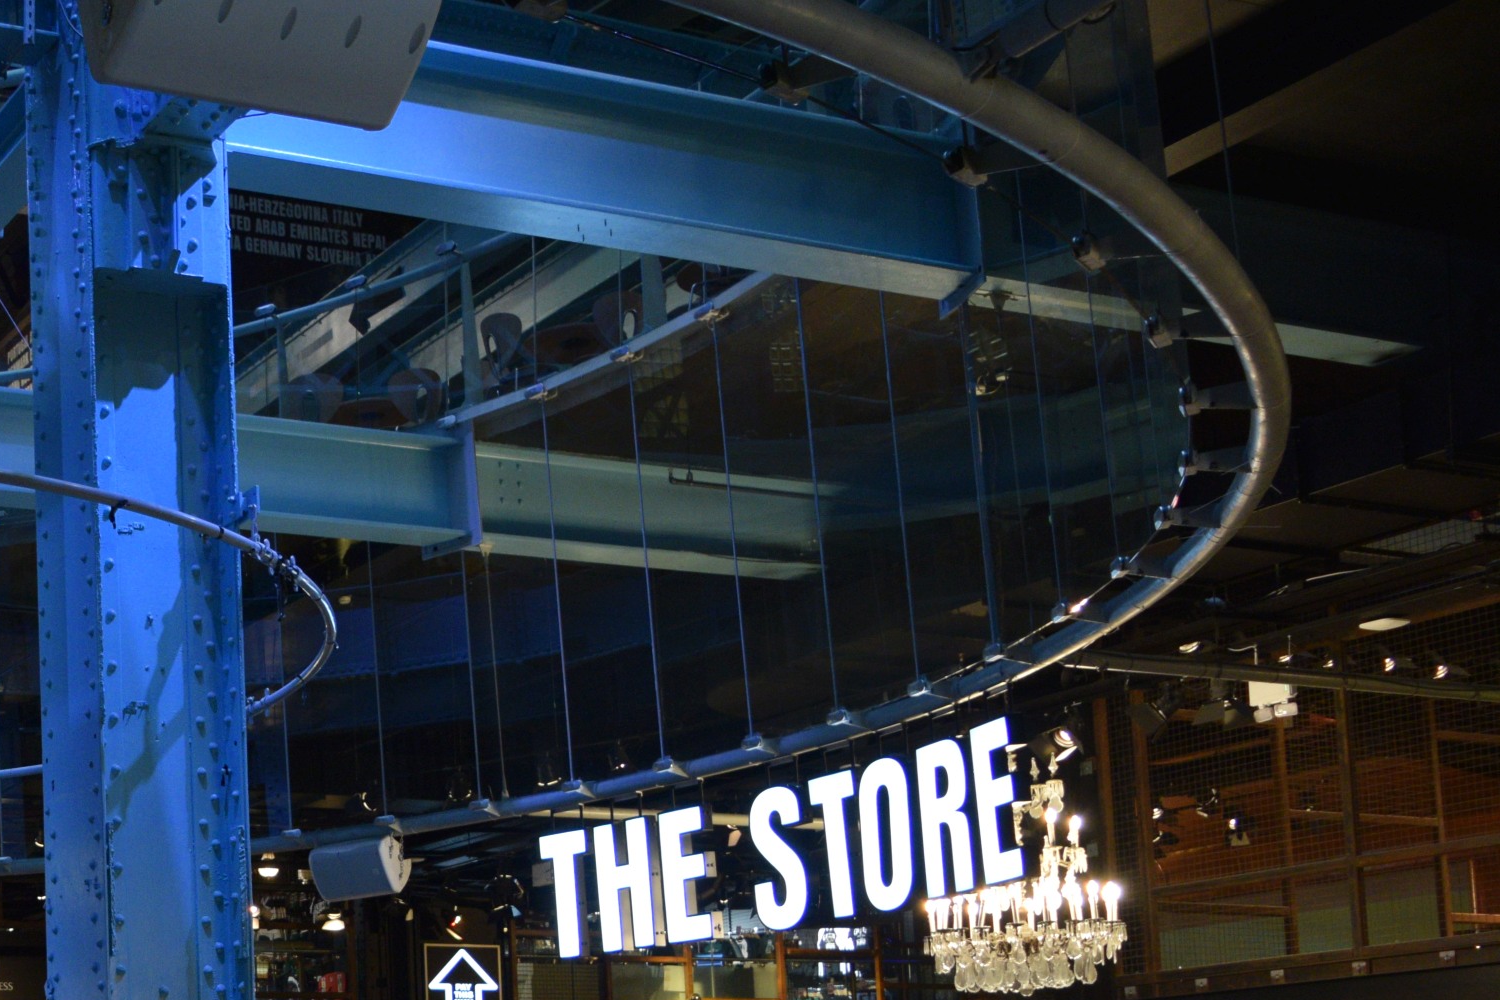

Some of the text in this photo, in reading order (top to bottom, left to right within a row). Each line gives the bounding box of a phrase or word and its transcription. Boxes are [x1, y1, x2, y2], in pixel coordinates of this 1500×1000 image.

[230, 214, 251, 232] TED
[255, 217, 286, 237] ARAB
[290, 224, 349, 246] EMIRATES
[333, 207, 364, 228] ITALY
[245, 236, 303, 260] GERMANY
[306, 243, 363, 267] SLOVENIA
[538, 716, 1025, 960] THE STORE
